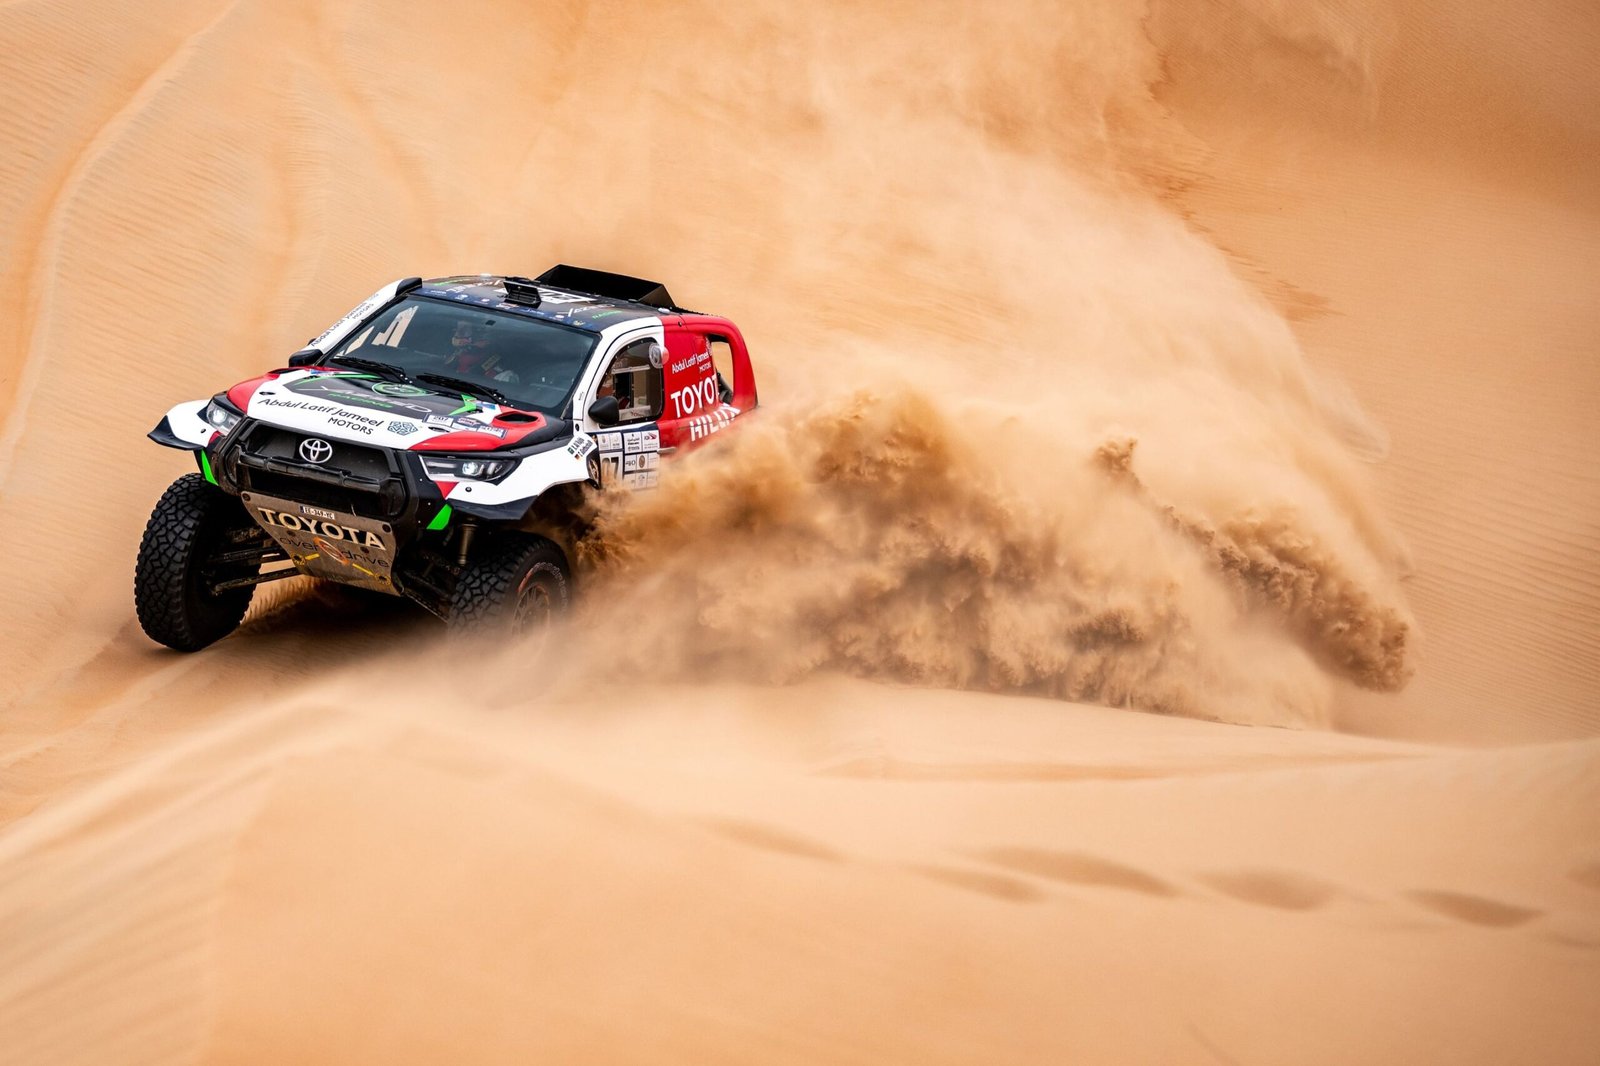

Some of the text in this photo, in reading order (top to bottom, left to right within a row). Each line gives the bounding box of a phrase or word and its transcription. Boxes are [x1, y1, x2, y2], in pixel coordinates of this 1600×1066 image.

[671, 358, 685, 374] Abdul
[684, 353, 696, 368] Latif
[670, 373, 719, 419] TOYOT
[257, 397, 386, 428] Abdul Latif Jameel
[327, 416, 374, 436] MOTORS
[257, 507, 387, 551] TOYOTA
